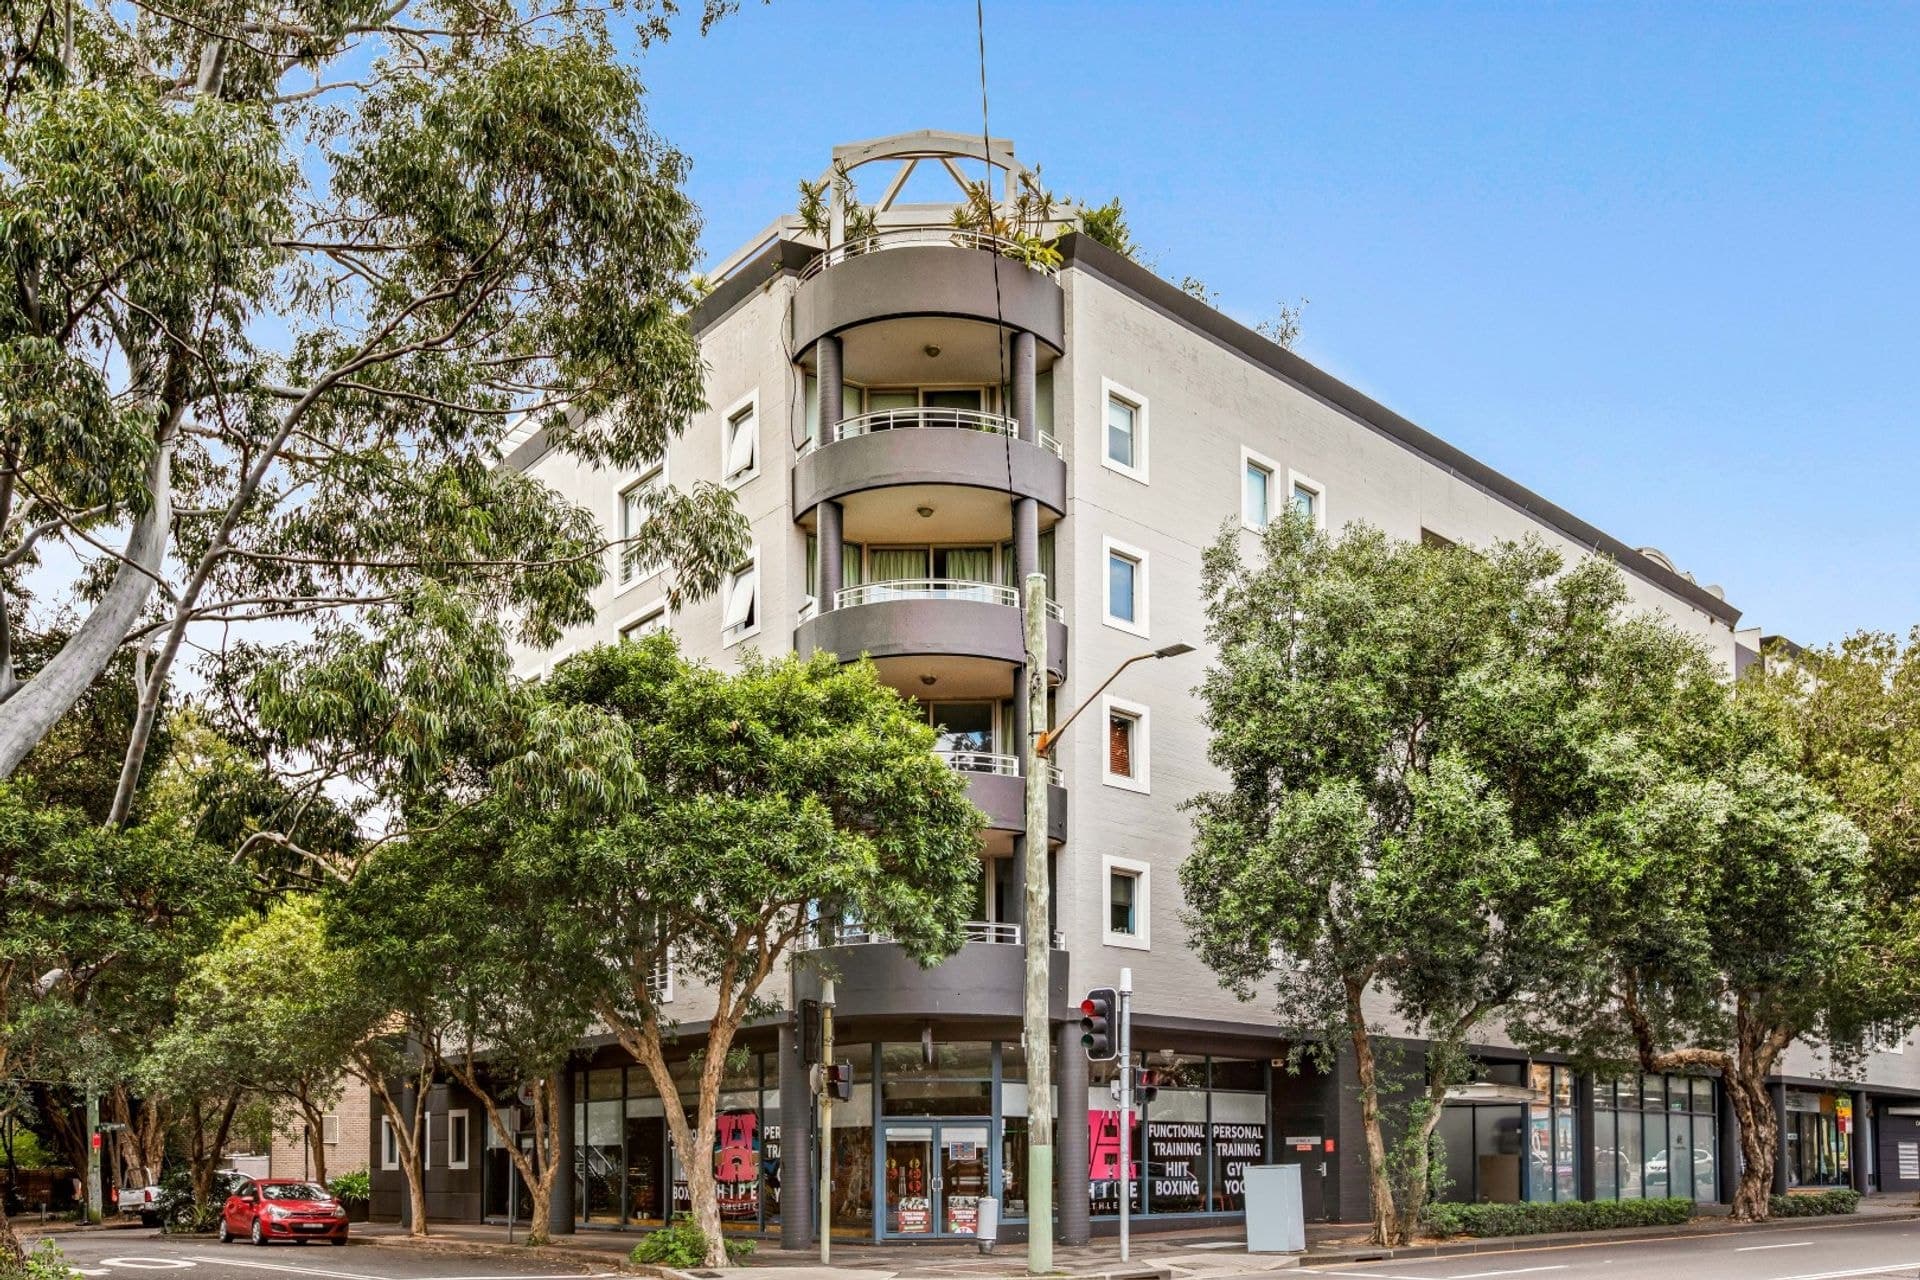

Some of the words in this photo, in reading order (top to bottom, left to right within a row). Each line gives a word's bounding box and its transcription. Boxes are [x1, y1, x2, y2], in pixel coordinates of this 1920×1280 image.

[1148, 1124, 1205, 1138] FUNCTIONAL
[1213, 1125, 1264, 1139] PERSONAL
[1153, 1143, 1202, 1156] TRAINING
[1216, 1143, 1261, 1157] TRAINING
[1165, 1162, 1189, 1177] HIIT
[1155, 1181, 1200, 1195] BOXING
